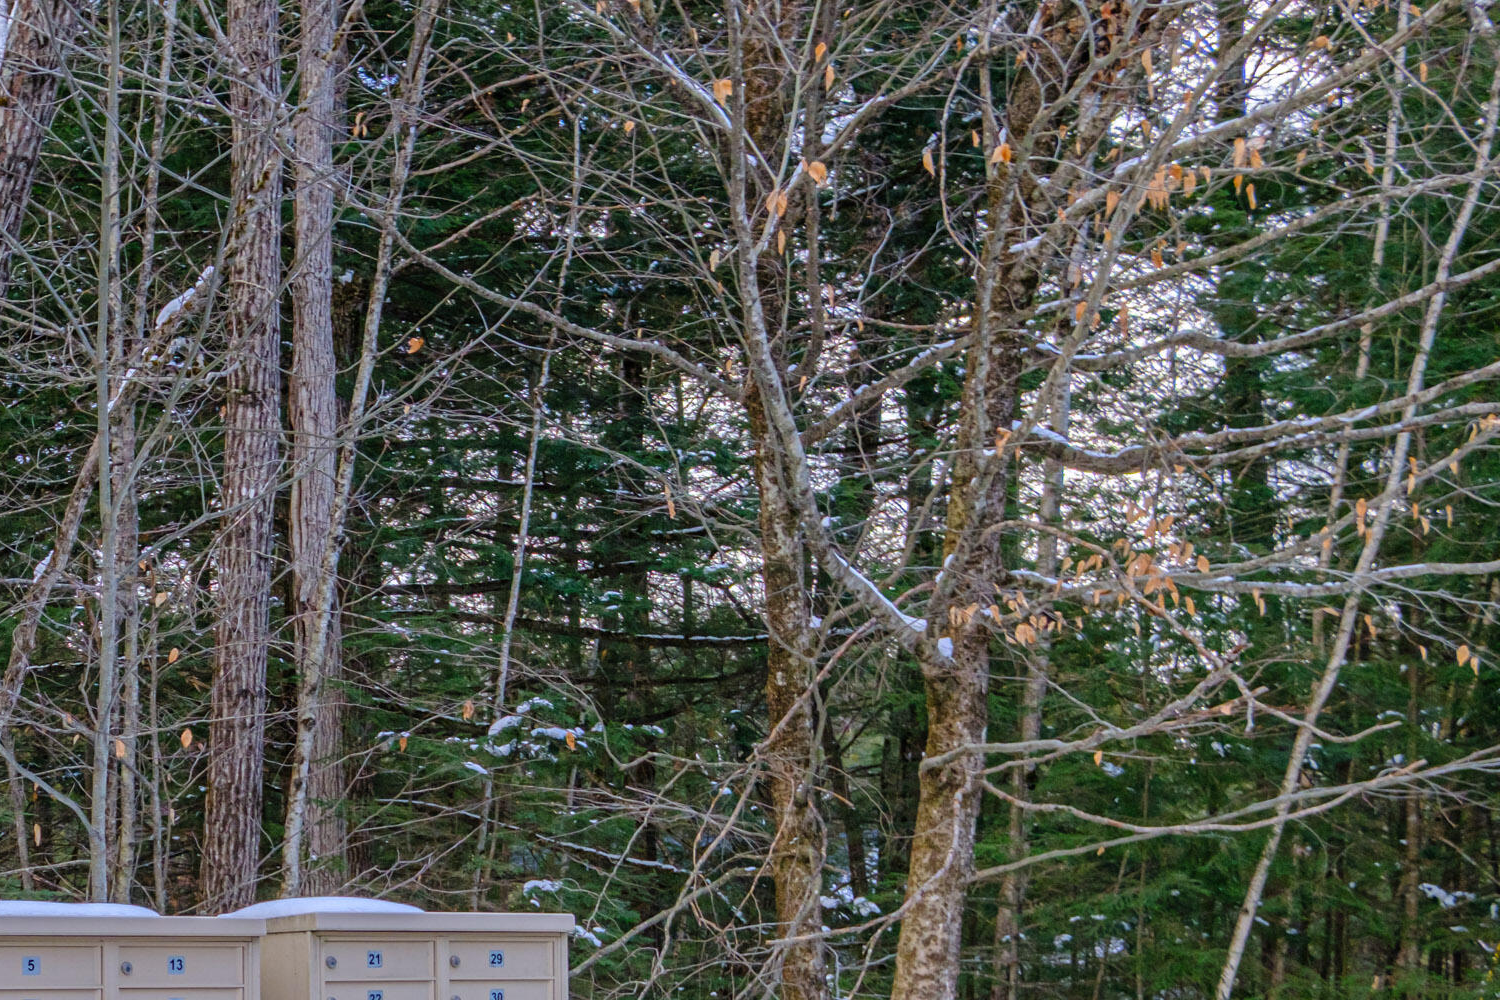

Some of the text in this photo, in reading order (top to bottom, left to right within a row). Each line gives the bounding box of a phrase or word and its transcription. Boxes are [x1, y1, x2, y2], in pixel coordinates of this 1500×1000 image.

[169, 958, 183, 971] 13
[367, 953, 382, 965] 21
[490, 953, 503, 965] 29
[26, 959, 36, 972] 5
